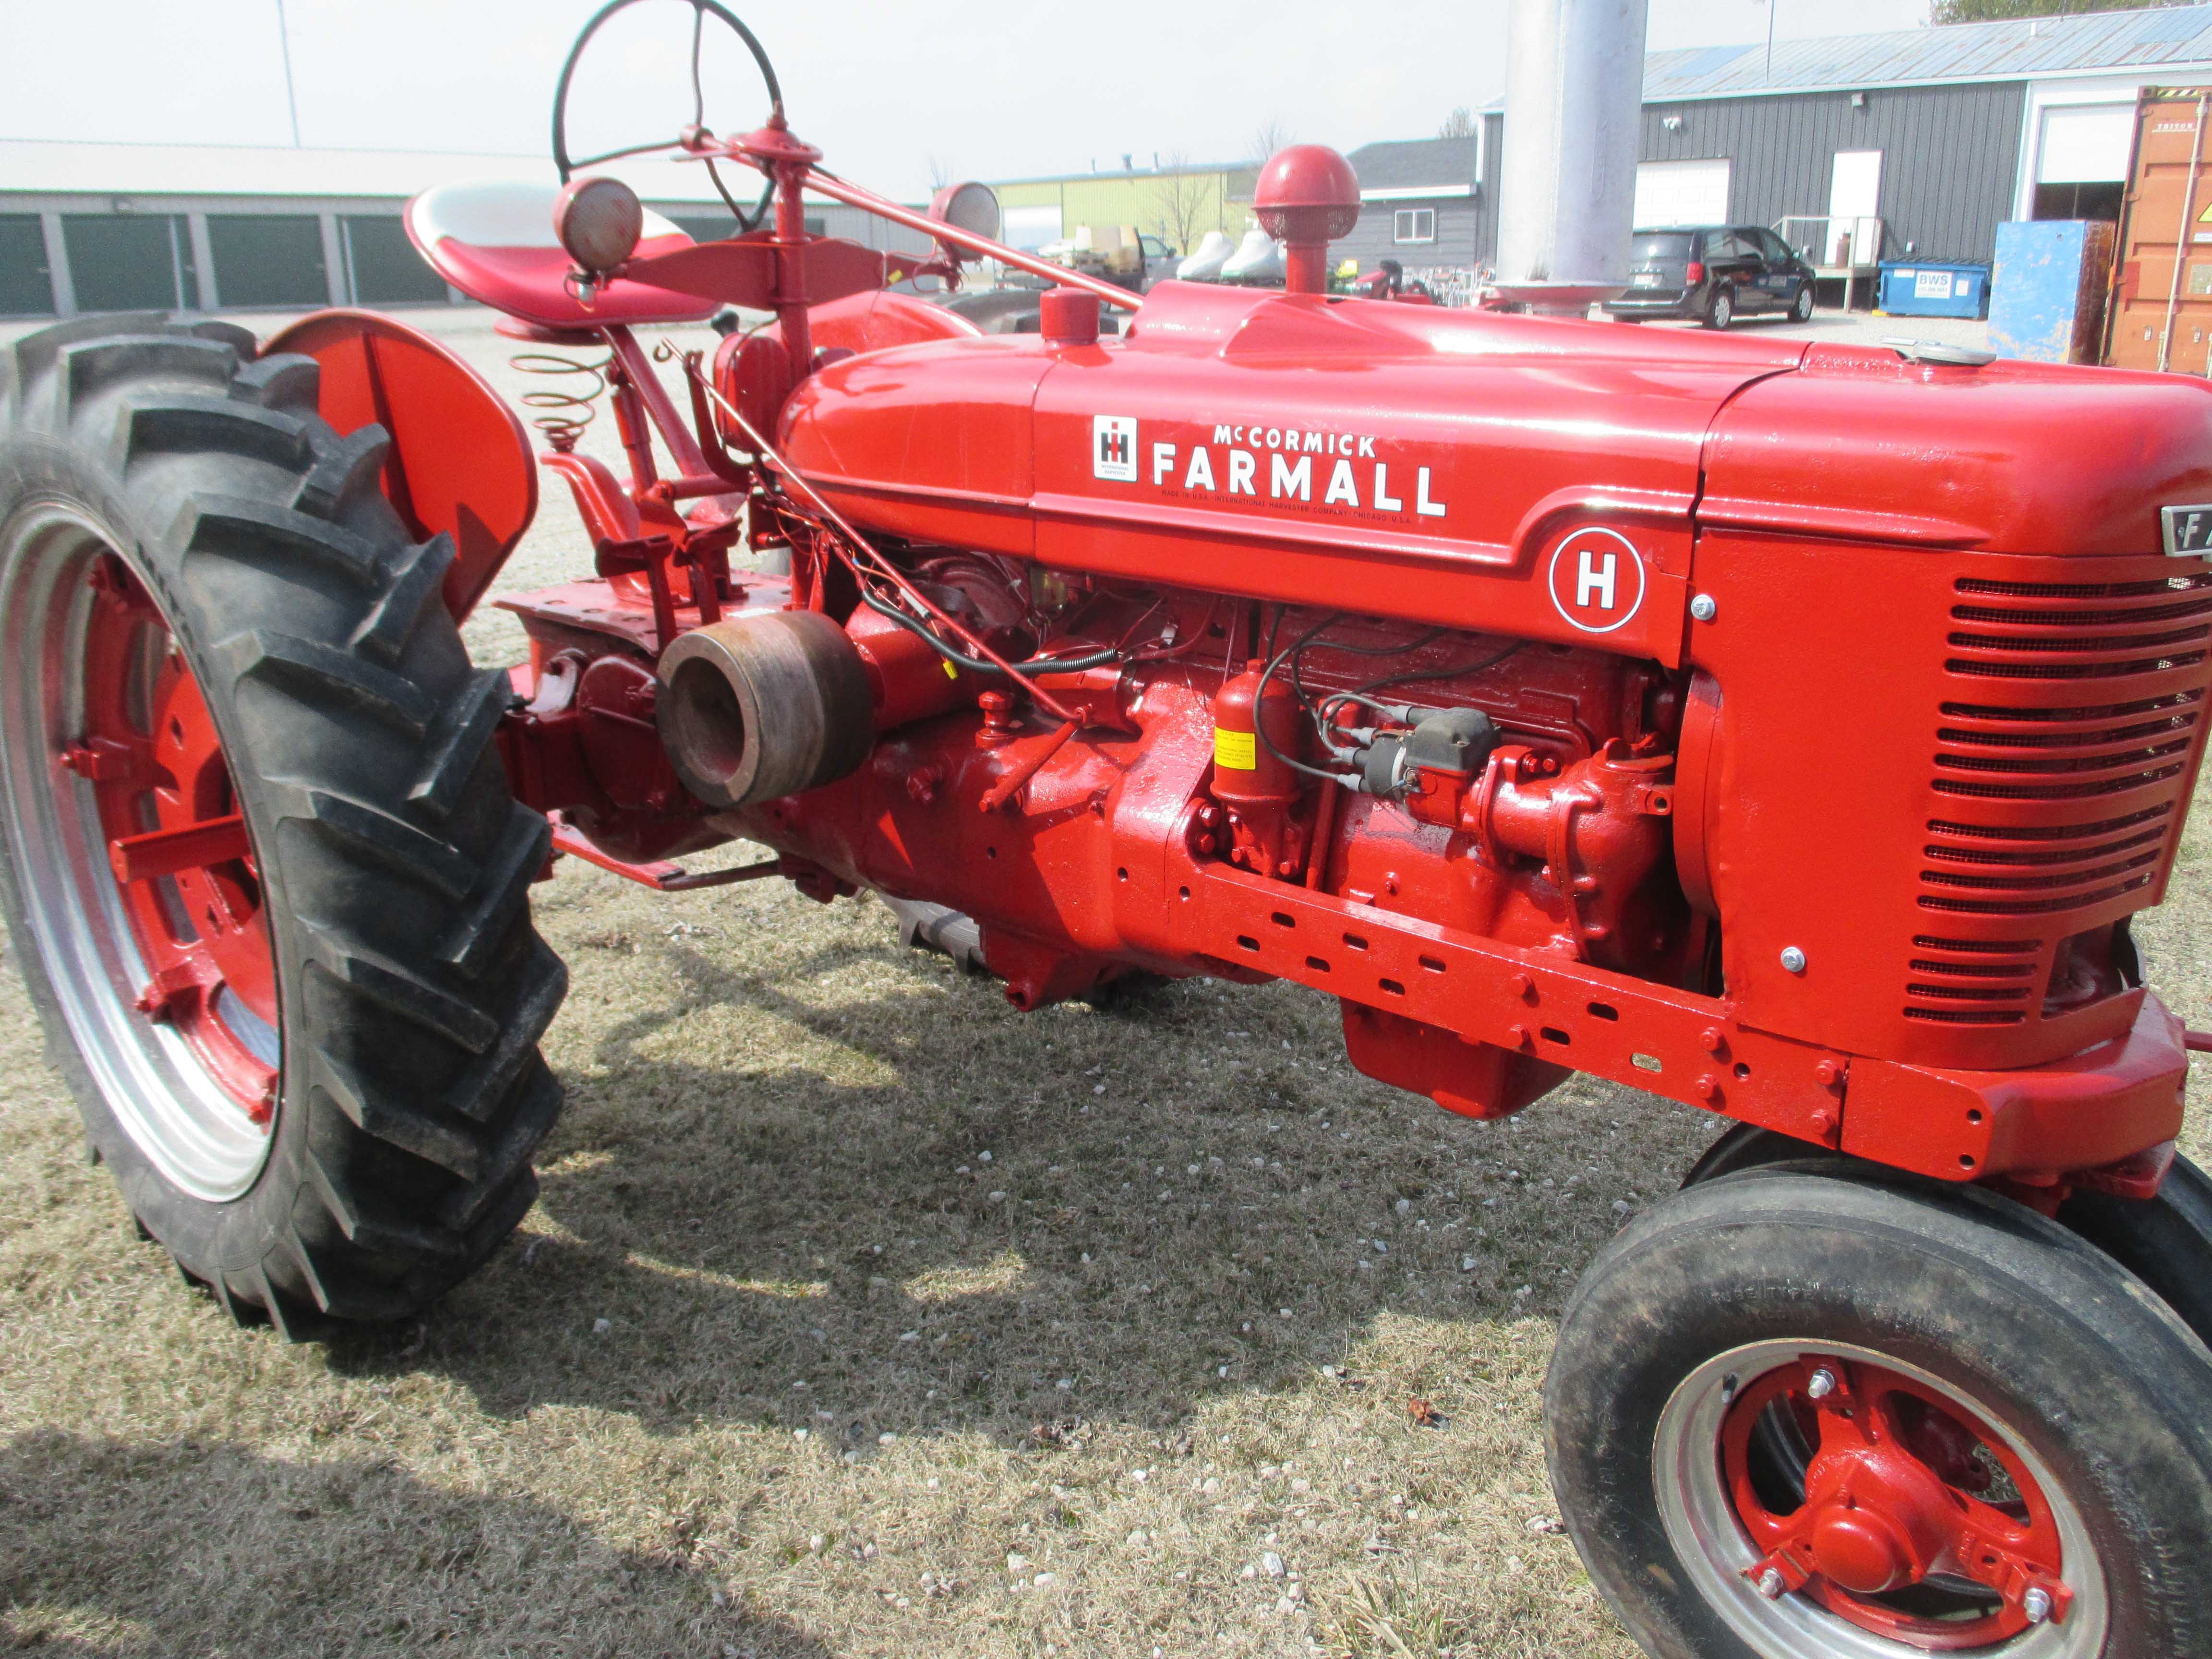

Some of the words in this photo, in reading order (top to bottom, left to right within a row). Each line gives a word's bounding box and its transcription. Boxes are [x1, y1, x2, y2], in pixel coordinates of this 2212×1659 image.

[1919, 274, 1948, 286] BWS
[1153, 442, 1447, 517] FARMALL
[1214, 496, 1265, 507] INTERNATIONAL
[1269, 502, 1309, 512] HARVESTER
[1314, 506, 1348, 517] COMPANY
[1354, 511, 1387, 521] CHICAGO
[1576, 551, 1617, 610] H
